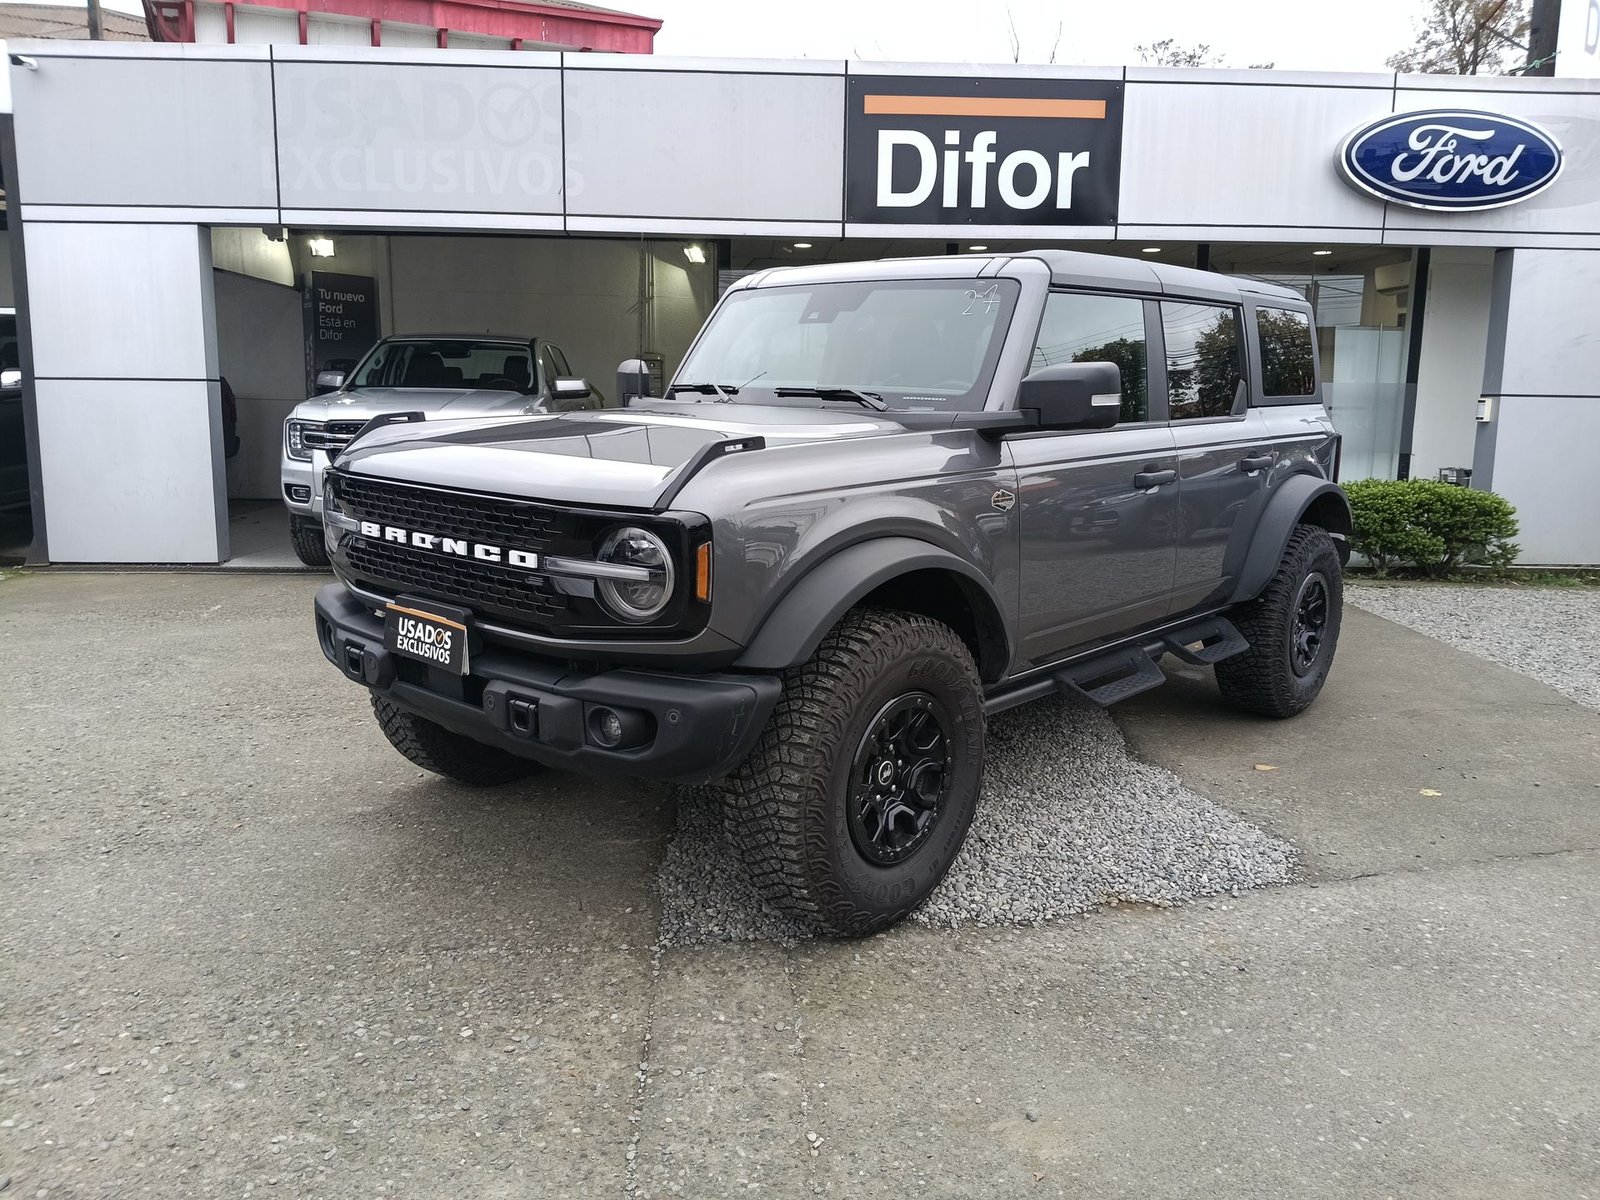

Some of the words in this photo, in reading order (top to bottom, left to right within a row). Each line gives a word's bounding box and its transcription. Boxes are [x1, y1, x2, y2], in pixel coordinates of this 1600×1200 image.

[259, 144, 587, 197] EXCLUSIVOS
[876, 129, 1090, 210] Difor
[1391, 124, 1525, 187] Ford
[318, 288, 332, 300] Tu
[333, 292, 365, 303] nuevo
[318, 302, 343, 314] Ford
[319, 315, 342, 328] Está
[343, 319, 356, 328] en
[319, 329, 343, 341] Difor
[360, 520, 538, 569] BRONCO
[398, 617, 452, 649] USADOS
[396, 635, 451, 664] EXCLUSIVOS
